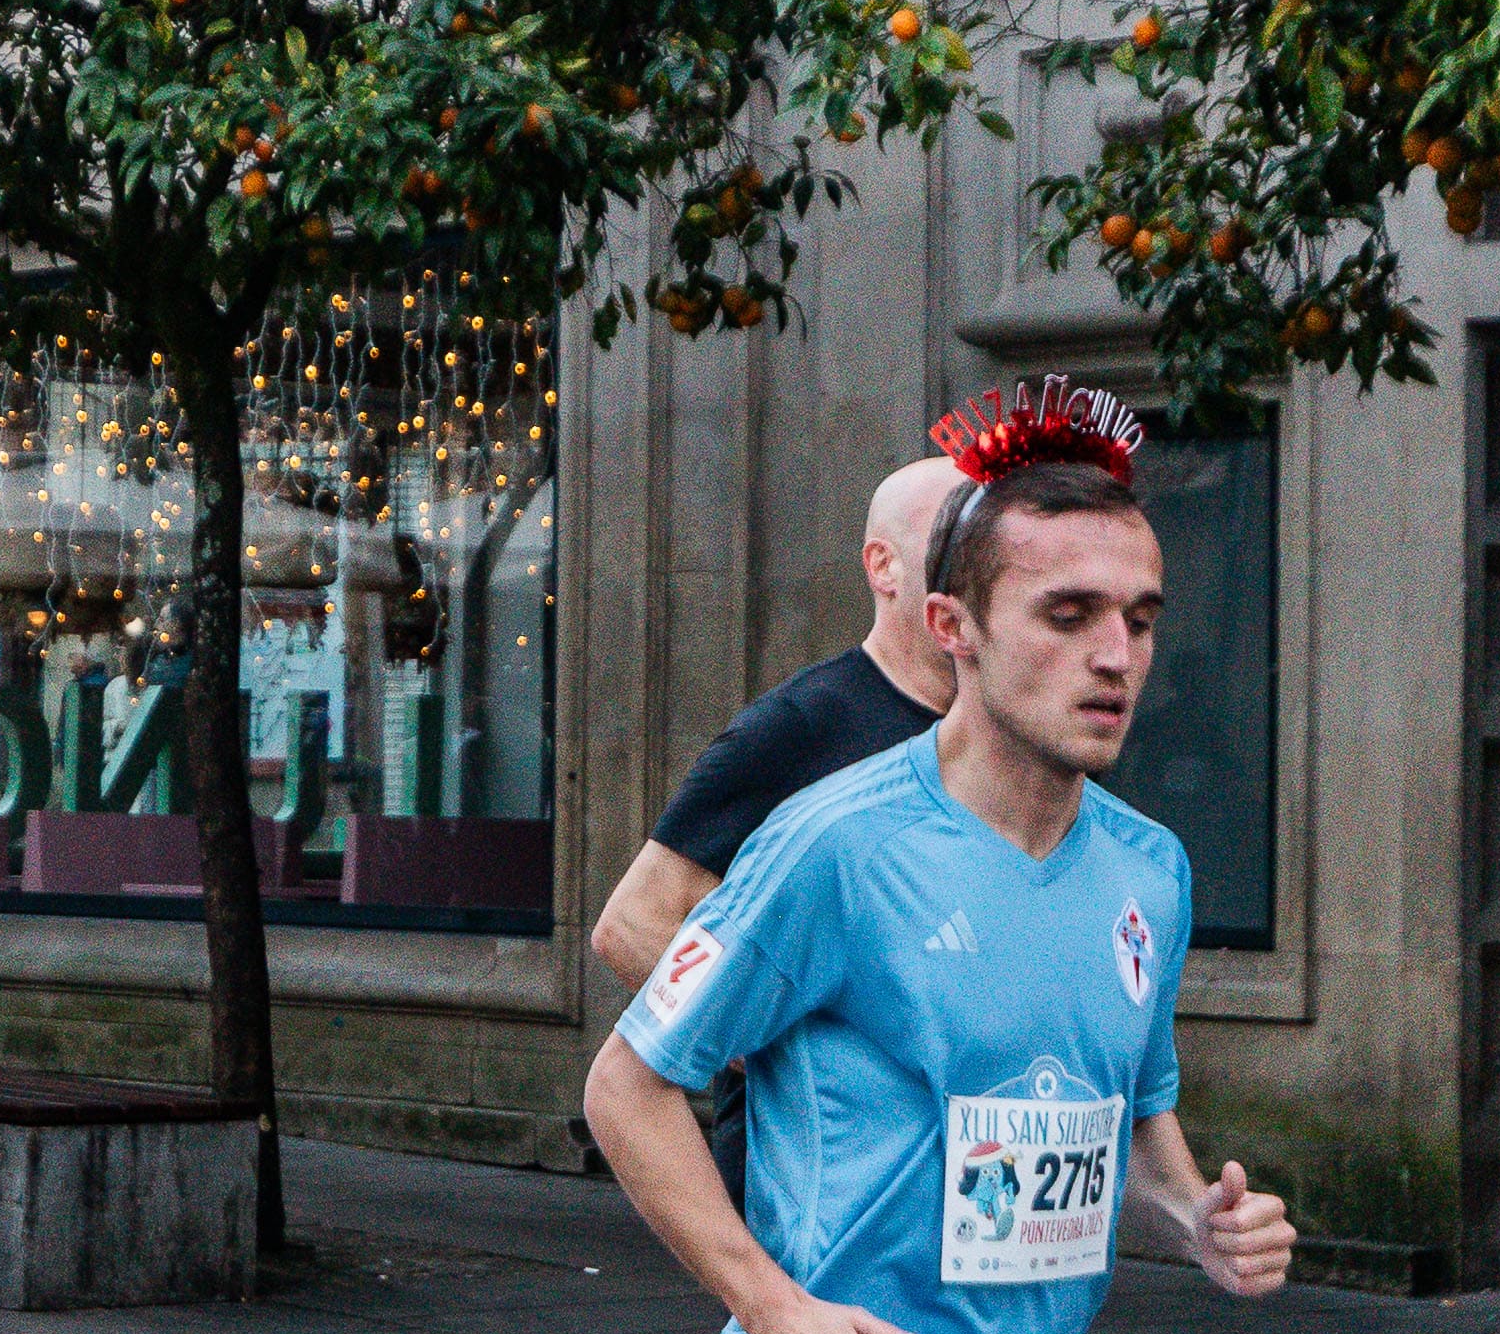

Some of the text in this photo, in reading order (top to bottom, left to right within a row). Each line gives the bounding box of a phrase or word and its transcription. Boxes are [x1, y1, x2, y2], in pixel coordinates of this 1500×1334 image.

[959, 1104, 1117, 1147] XLII SAN SILVESTRE
[1032, 1145, 1108, 1212] 2715
[1019, 1215, 1084, 1246] PONTEVEDRA
